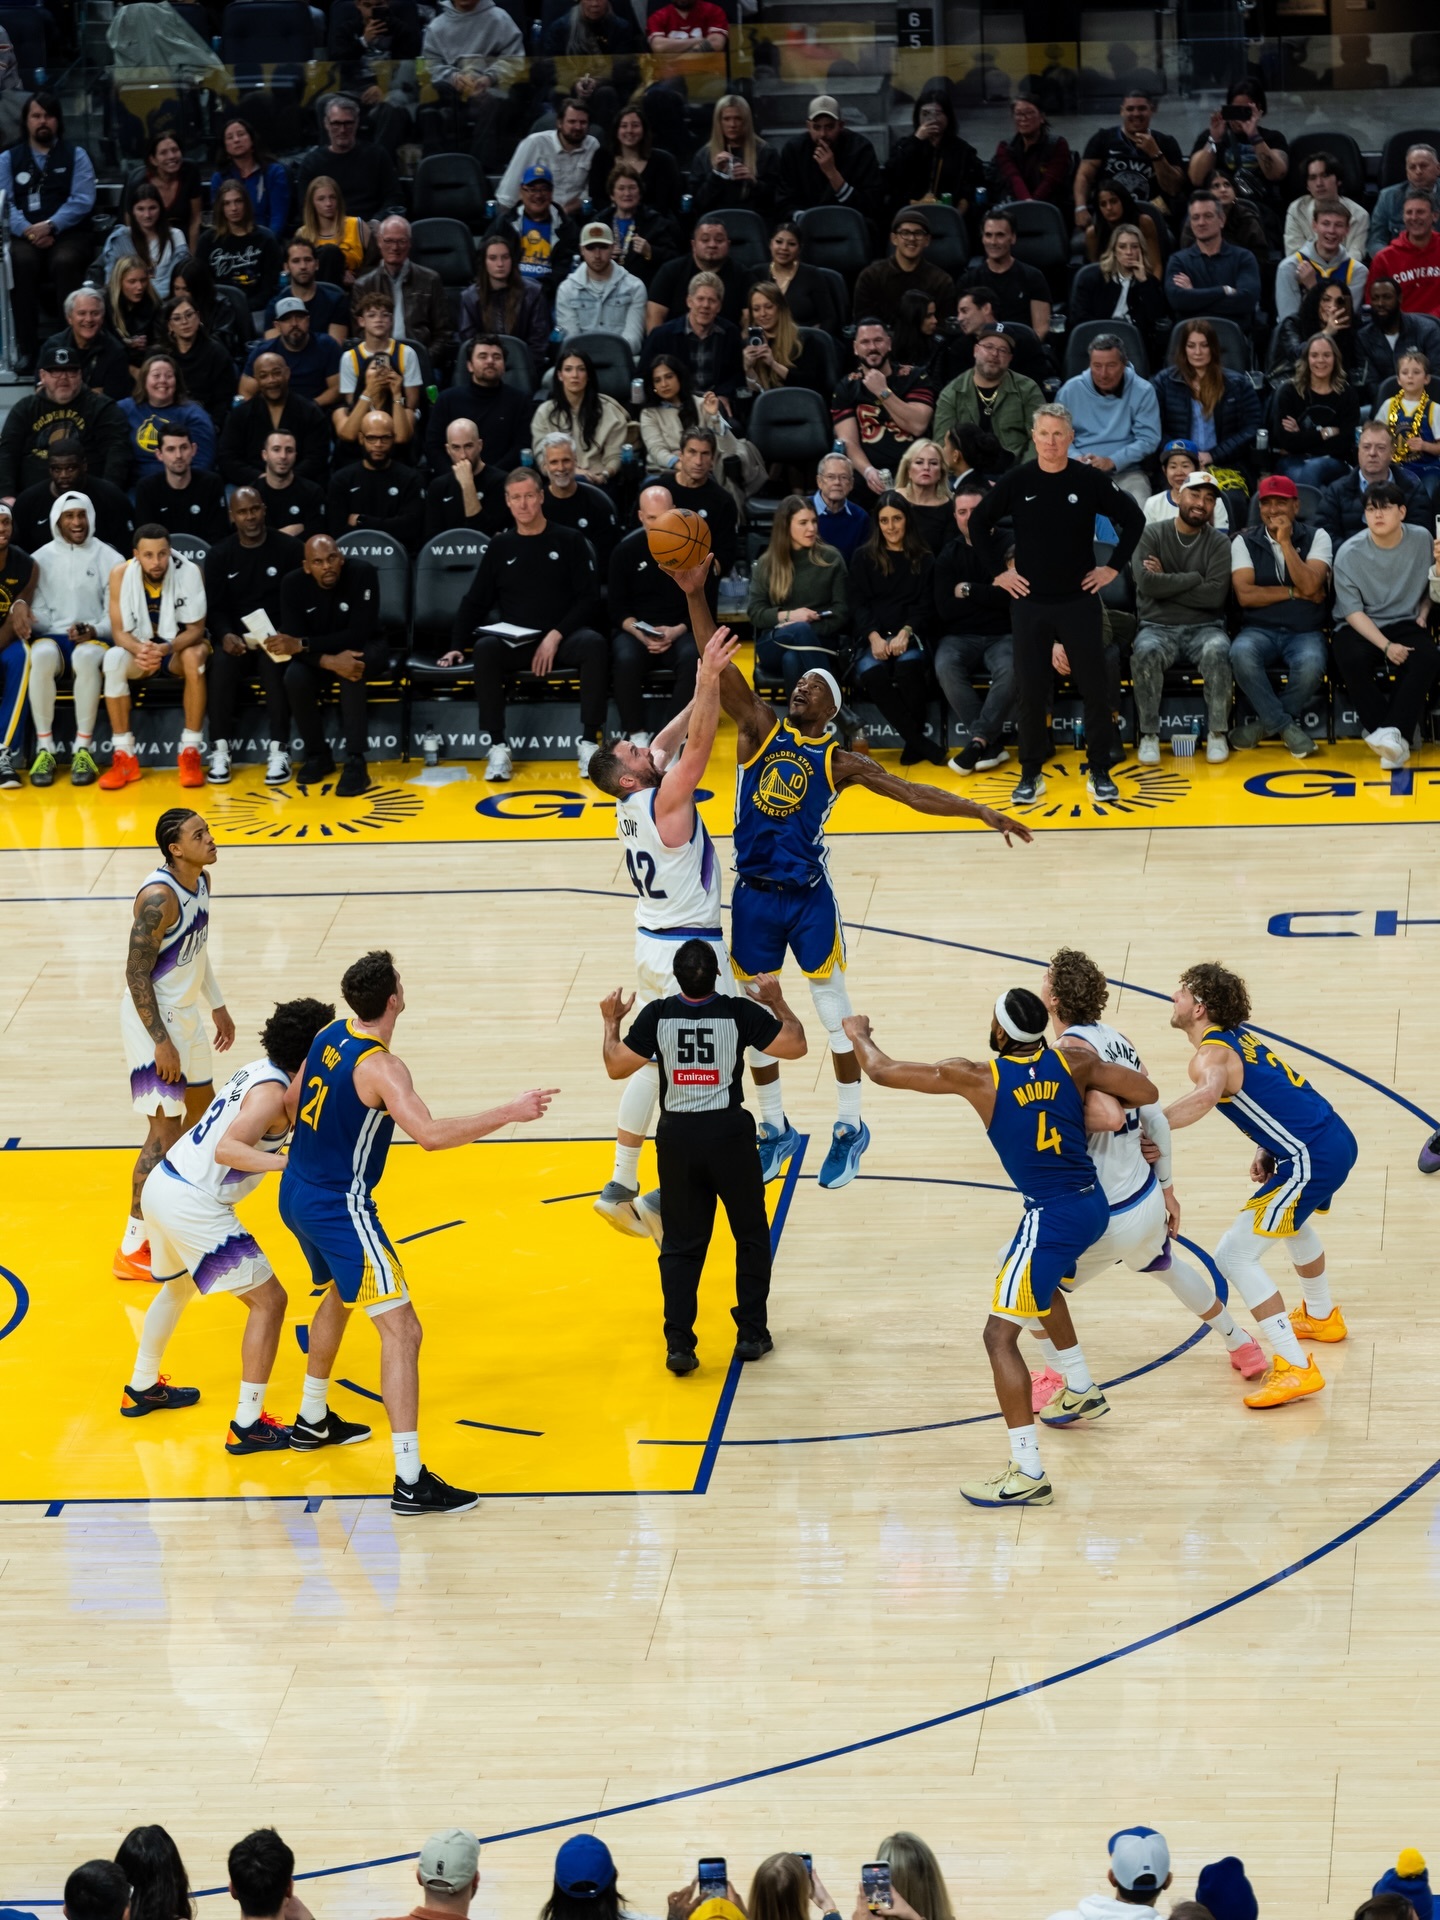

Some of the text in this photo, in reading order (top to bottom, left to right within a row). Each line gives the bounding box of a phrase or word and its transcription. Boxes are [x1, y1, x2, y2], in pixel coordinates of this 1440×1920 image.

[908, 12, 920, 27] 6
[910, 34, 922, 49] 5
[1392, 266, 1440, 284] CONVERS
[229, 738, 305, 750] WAYO
[764, 750, 815, 777] GOLDEN STATE
[789, 773, 804, 790] 10
[751, 791, 802, 818] WARRIORS
[619, 818, 638, 838] LOVE
[625, 847, 668, 900] 42
[321, 1044, 342, 1071] POST
[677, 1027, 715, 1065] 55
[677, 1072, 715, 1082] Emirates
[300, 1075, 329, 1131] 21
[1012, 1080, 1060, 1107] MOODY
[1036, 1110, 1062, 1155] 4
